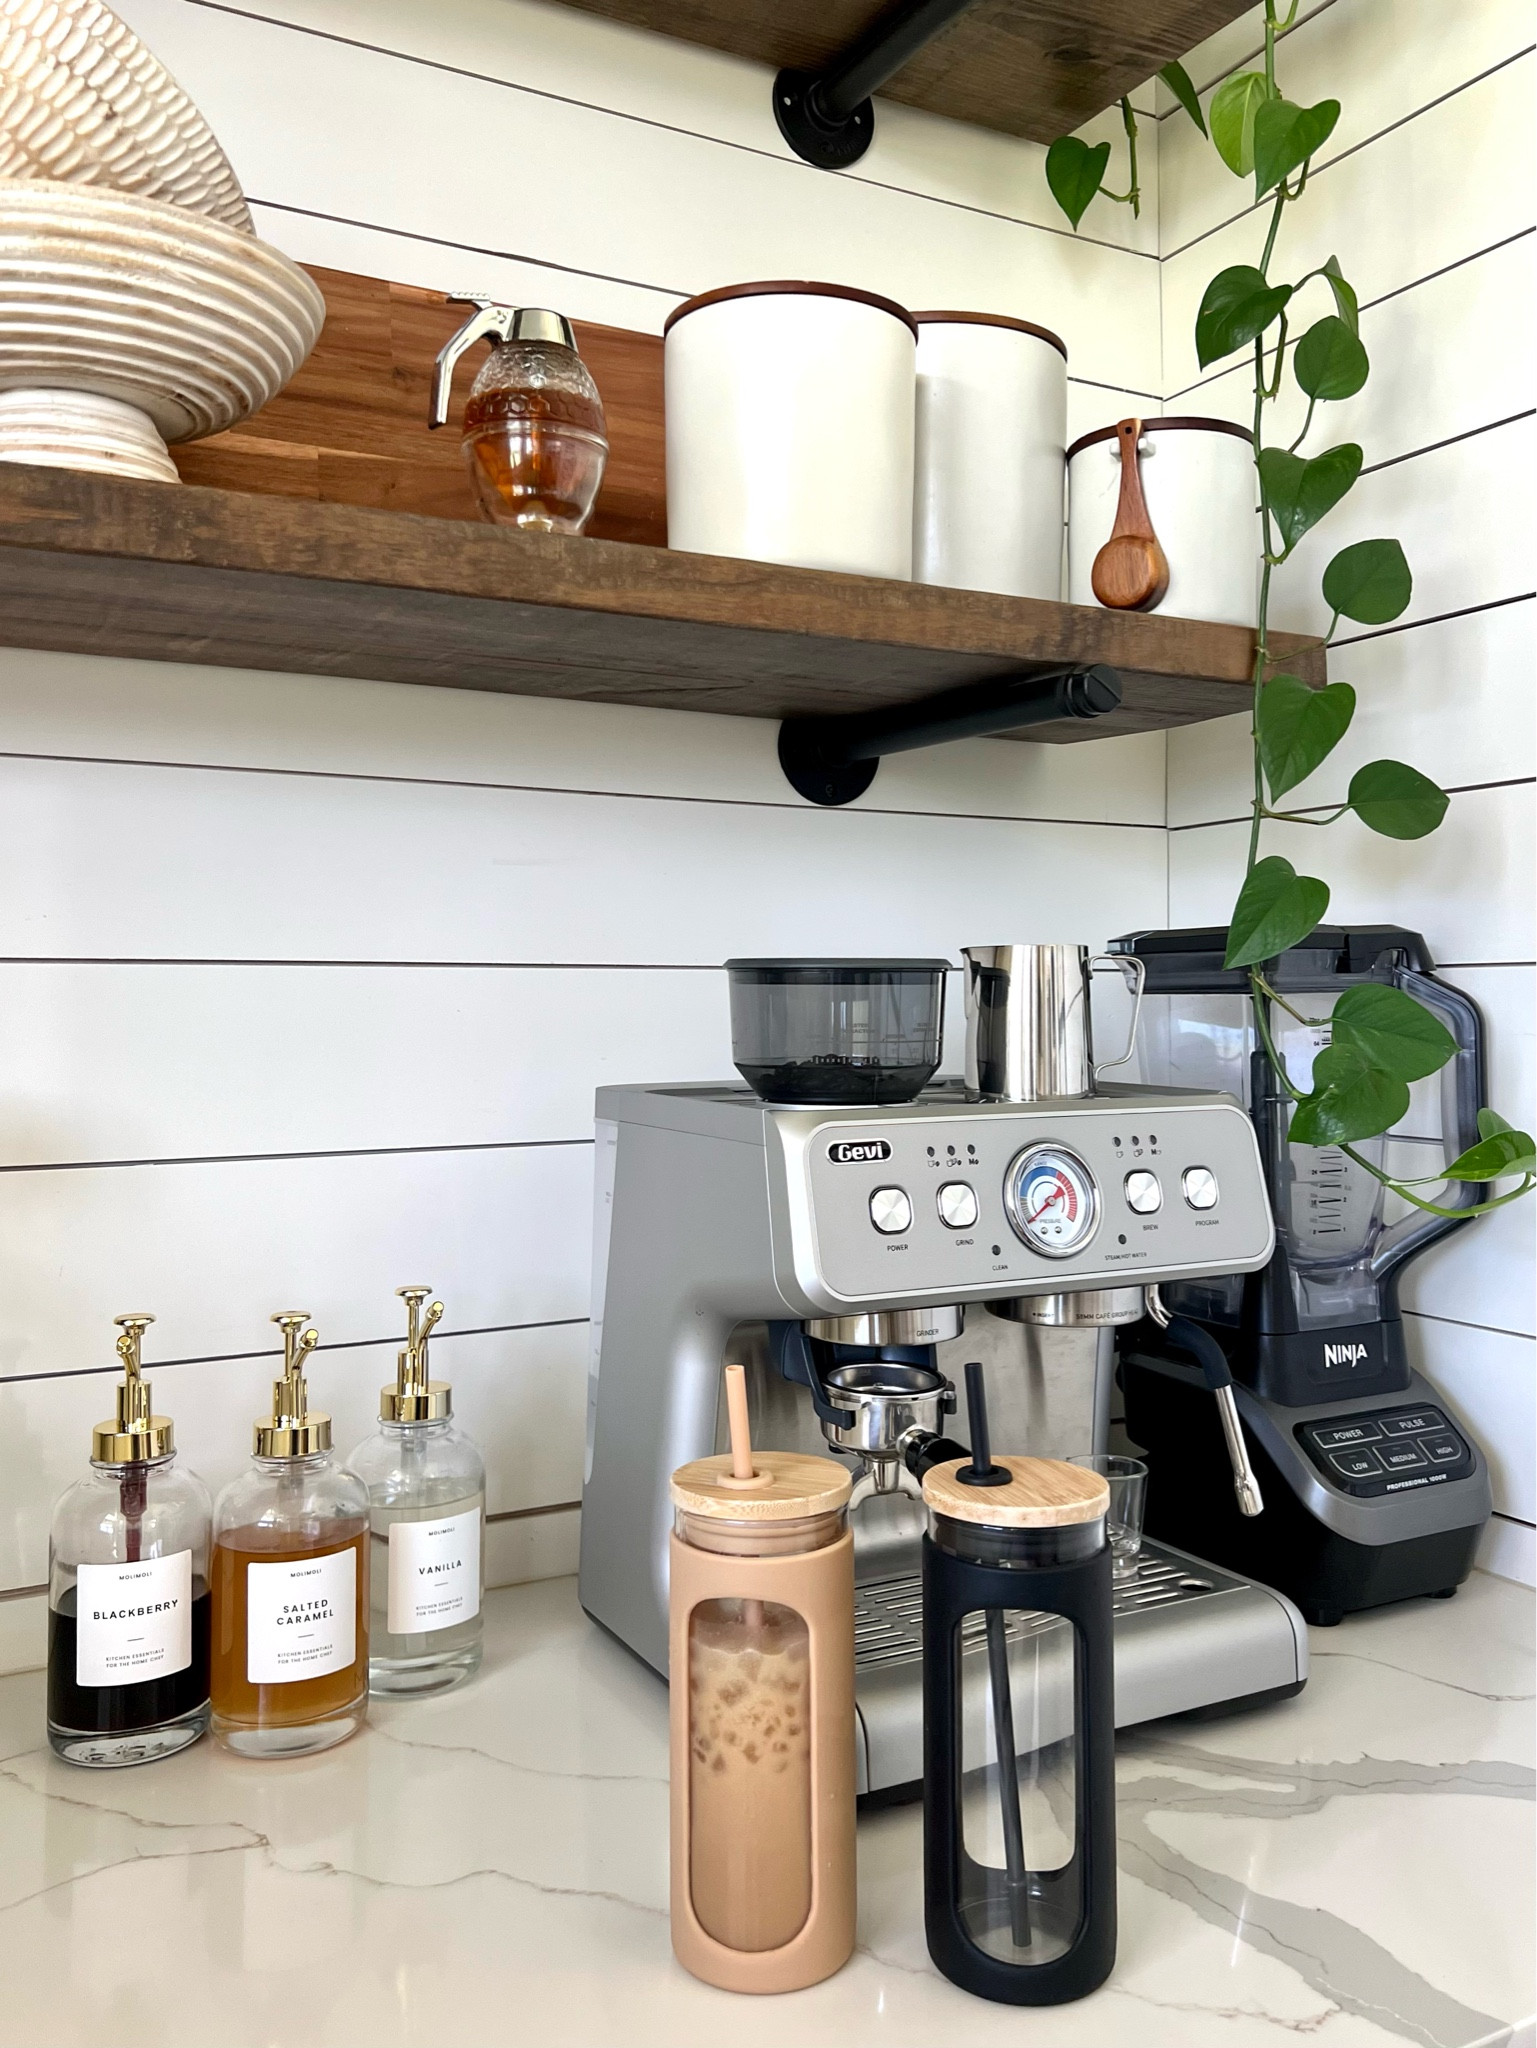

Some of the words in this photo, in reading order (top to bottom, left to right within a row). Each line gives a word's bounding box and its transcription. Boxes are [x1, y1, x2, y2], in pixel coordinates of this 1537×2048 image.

[838, 1142, 884, 1161] Gevi
[1142, 1223, 1159, 1231] BREW
[1194, 1218, 1220, 1227] PROGRAM
[955, 1238, 974, 1246] GRIND
[886, 1244, 909, 1252] POWER
[916, 1328, 939, 1337] GRINDER
[1324, 1343, 1368, 1368] NINJA
[1398, 1418, 1425, 1430] PULSE
[1332, 1428, 1364, 1441] POWER
[1435, 1446, 1454, 1455] HIGH
[1389, 1452, 1417, 1464] MEDIUM
[1351, 1461, 1369, 1471] LOW
[1386, 1477, 1428, 1491] PROFESSIONAL
[428, 1527, 455, 1536] MOLIMOLI
[418, 1559, 462, 1575] VANILLA
[119, 1571, 153, 1580] MOLIMOLI
[290, 1568, 322, 1578] MOLIMOLI
[93, 1599, 179, 1620] BLACKBERRY
[283, 1598, 329, 1614] SALTED
[276, 1609, 334, 1625] CARAMEL
[132, 1648, 164, 1658] ESSENTIALS
[303, 1644, 333, 1655] ESSENTIALS
[150, 1654, 164, 1662] CHEF
